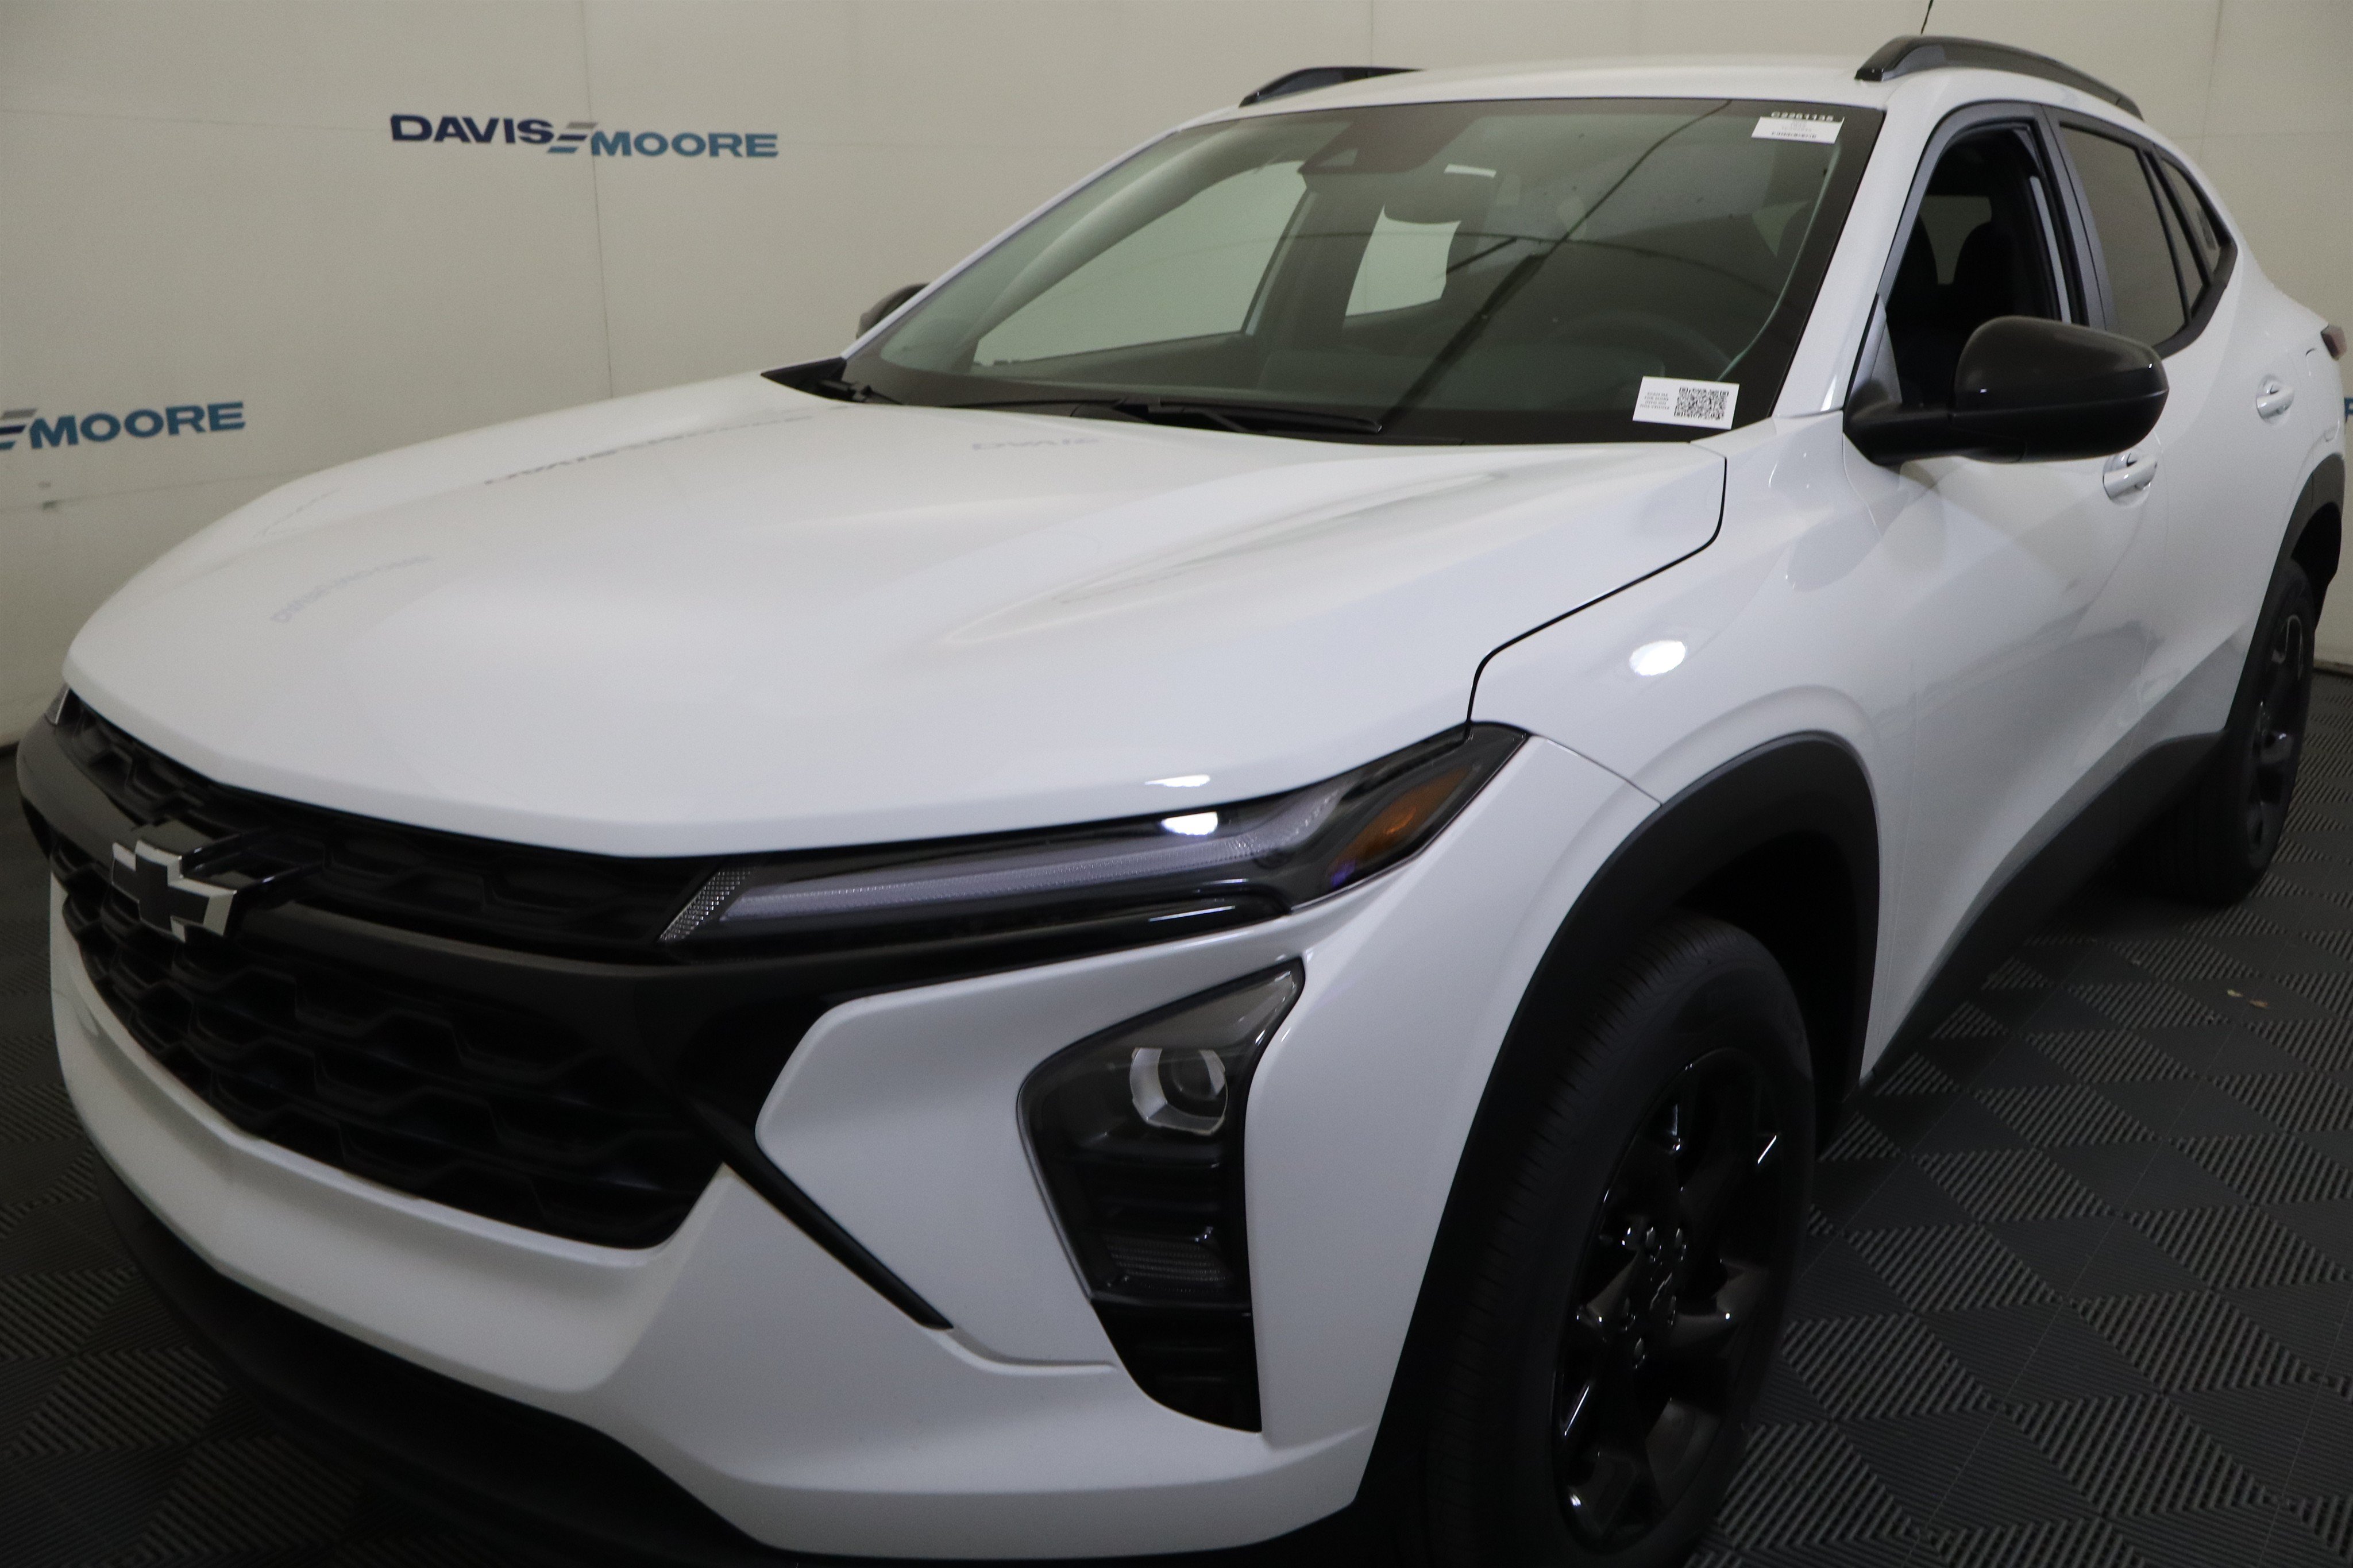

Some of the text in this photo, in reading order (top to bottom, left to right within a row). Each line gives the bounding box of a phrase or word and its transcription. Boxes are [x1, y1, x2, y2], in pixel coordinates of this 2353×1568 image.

[390, 114, 780, 158] DAVIS MOORE
[29, 401, 246, 449] MOORE
